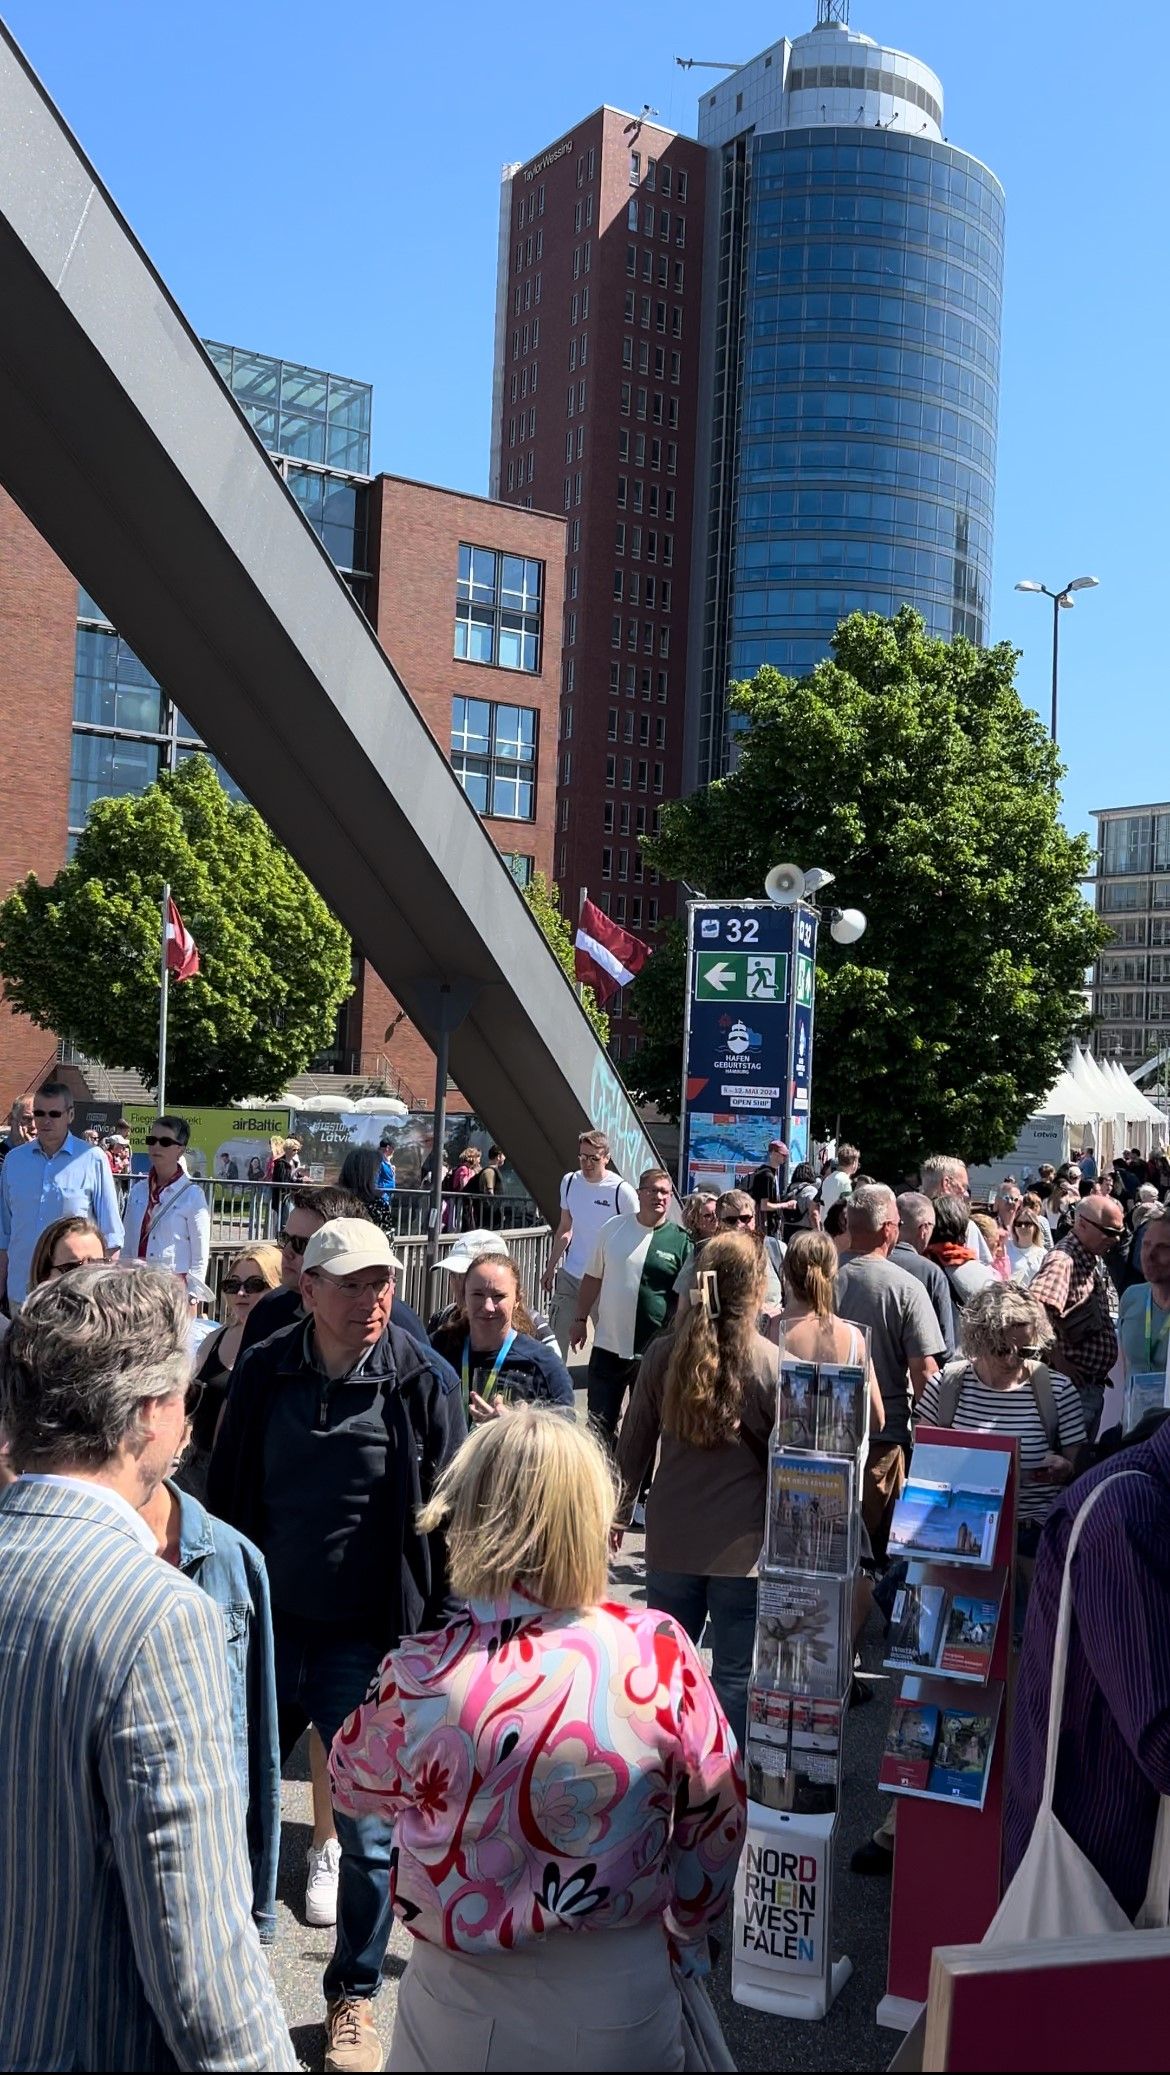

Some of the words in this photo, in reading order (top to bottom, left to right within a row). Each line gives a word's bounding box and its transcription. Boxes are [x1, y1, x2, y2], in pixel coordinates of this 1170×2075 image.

[726, 918, 760, 943] 32
[725, 1054, 750, 1062] HAFEN
[713, 1061, 762, 1070] GEBURTSTAG
[131, 1112, 155, 1126] Fliege
[232, 1118, 282, 1132] airBaltic
[130, 1126, 146, 1134] von
[129, 1137, 147, 1145] nac
[746, 1843, 817, 1883] NORD
[745, 1872, 816, 1911] RHEIN
[743, 1898, 815, 1936] WEST
[743, 1925, 814, 1962] FALEN
